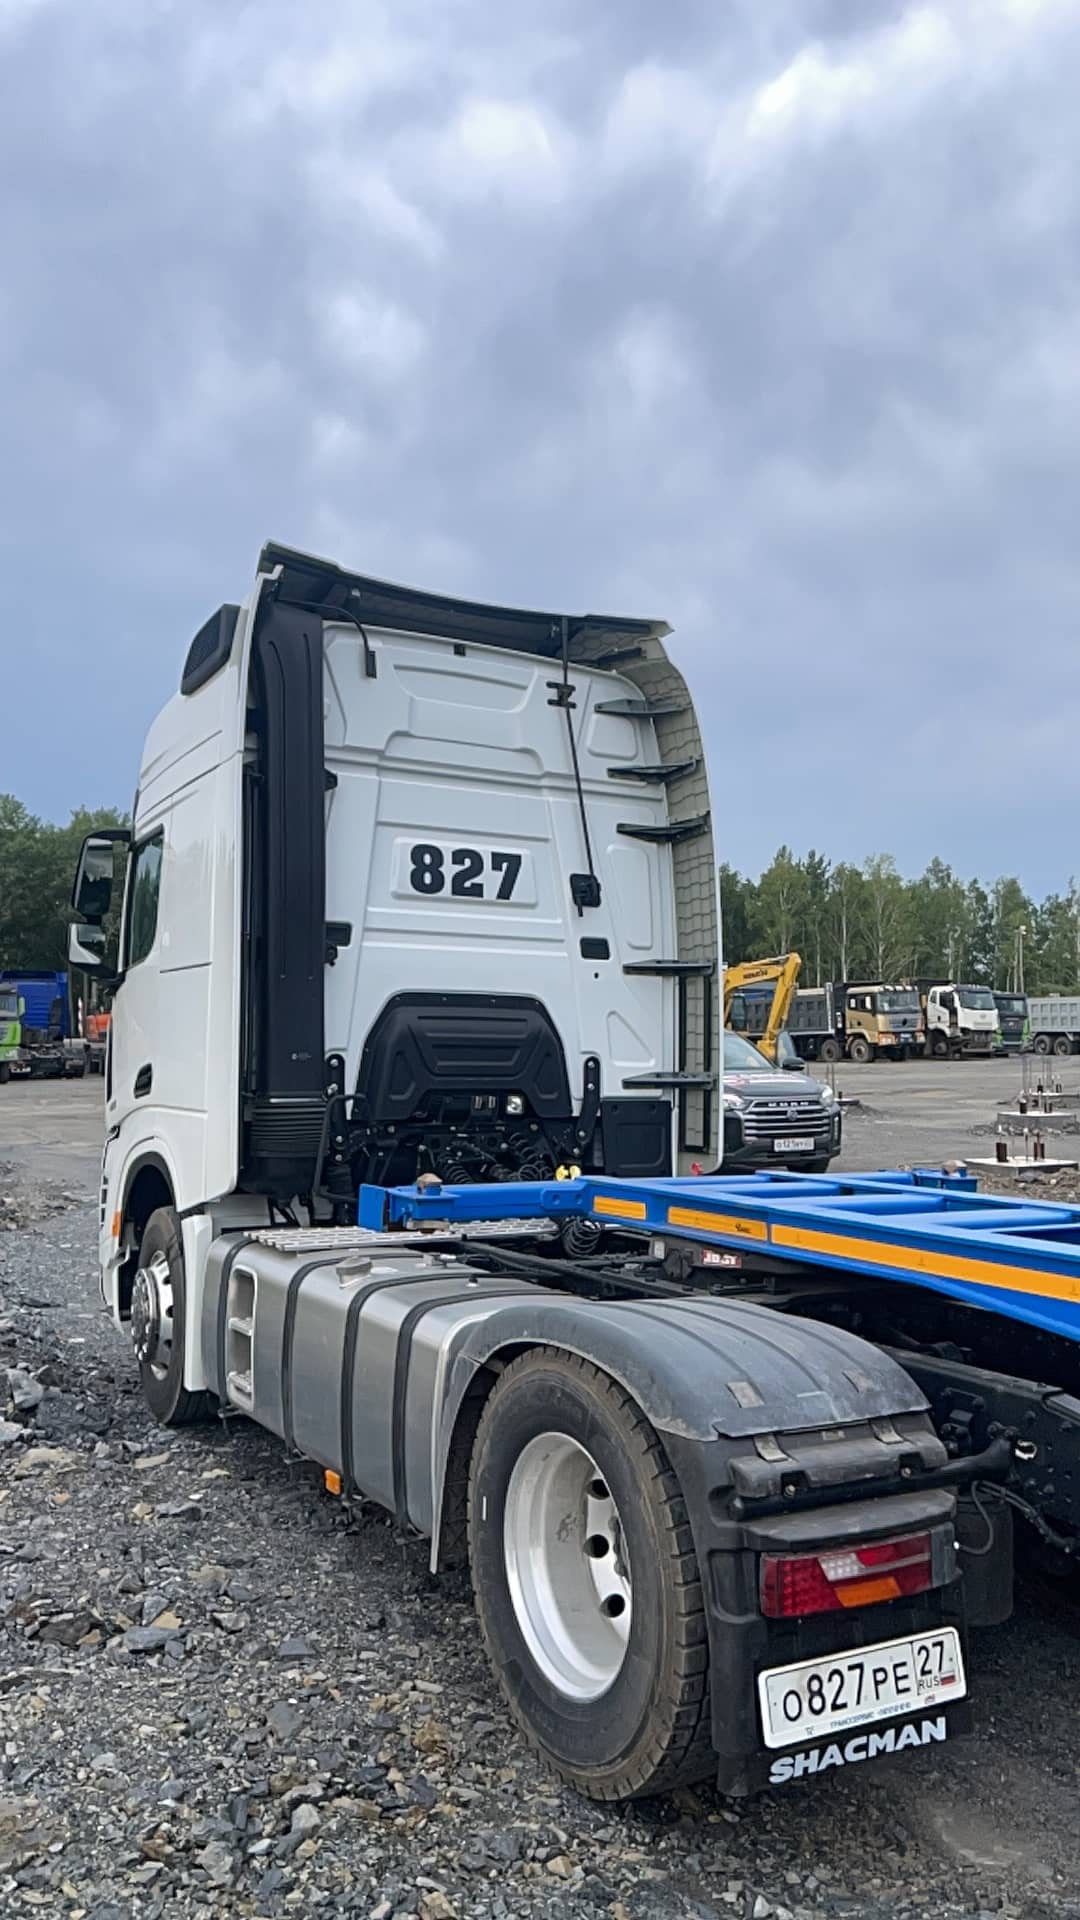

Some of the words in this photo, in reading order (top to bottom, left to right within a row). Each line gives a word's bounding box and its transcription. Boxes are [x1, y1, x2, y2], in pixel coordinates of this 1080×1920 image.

[410, 844, 522, 900] 827
[917, 1641, 945, 1676] 27
[918, 1678, 940, 1690] RUS
[769, 1717, 947, 1784] SHACMAN
